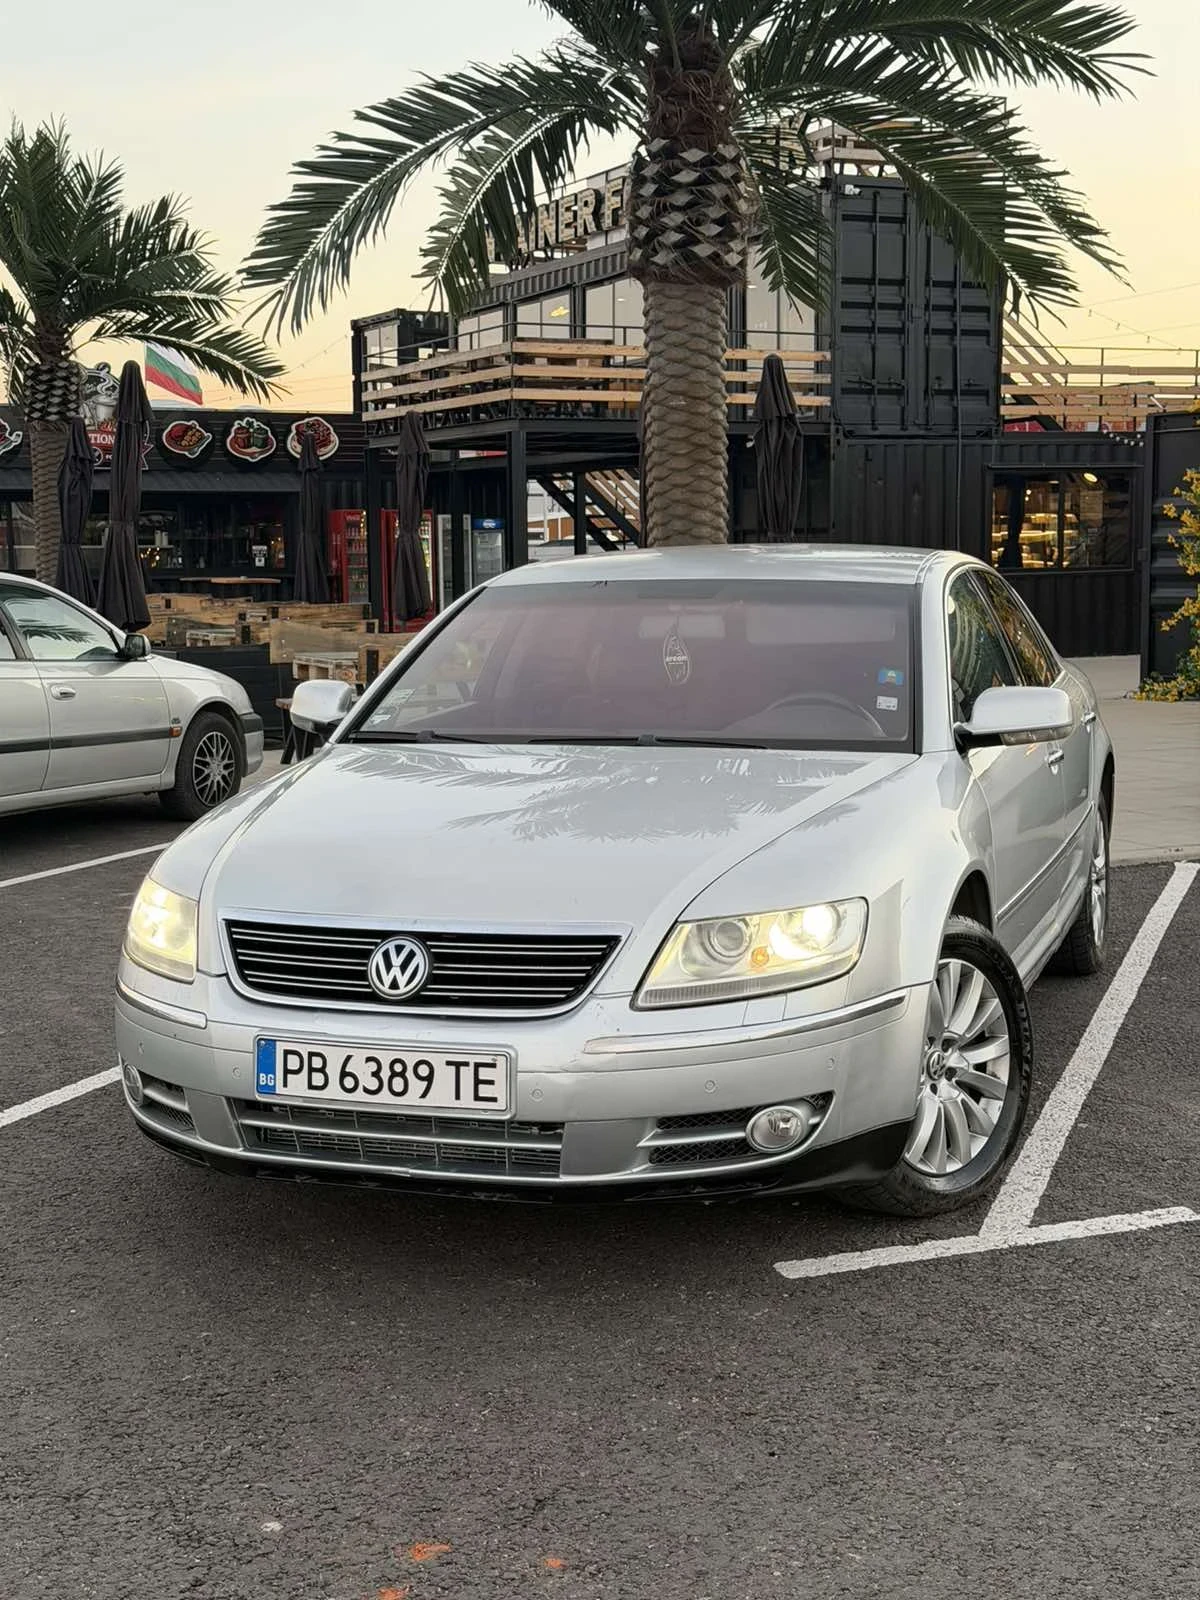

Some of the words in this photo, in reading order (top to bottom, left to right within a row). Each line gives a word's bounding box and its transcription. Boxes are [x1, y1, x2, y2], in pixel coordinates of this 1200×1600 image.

[258, 1073, 275, 1087] BG
[282, 1048, 330, 1092] PB
[338, 1053, 435, 1099] 6389
[445, 1059, 499, 1103] TE
